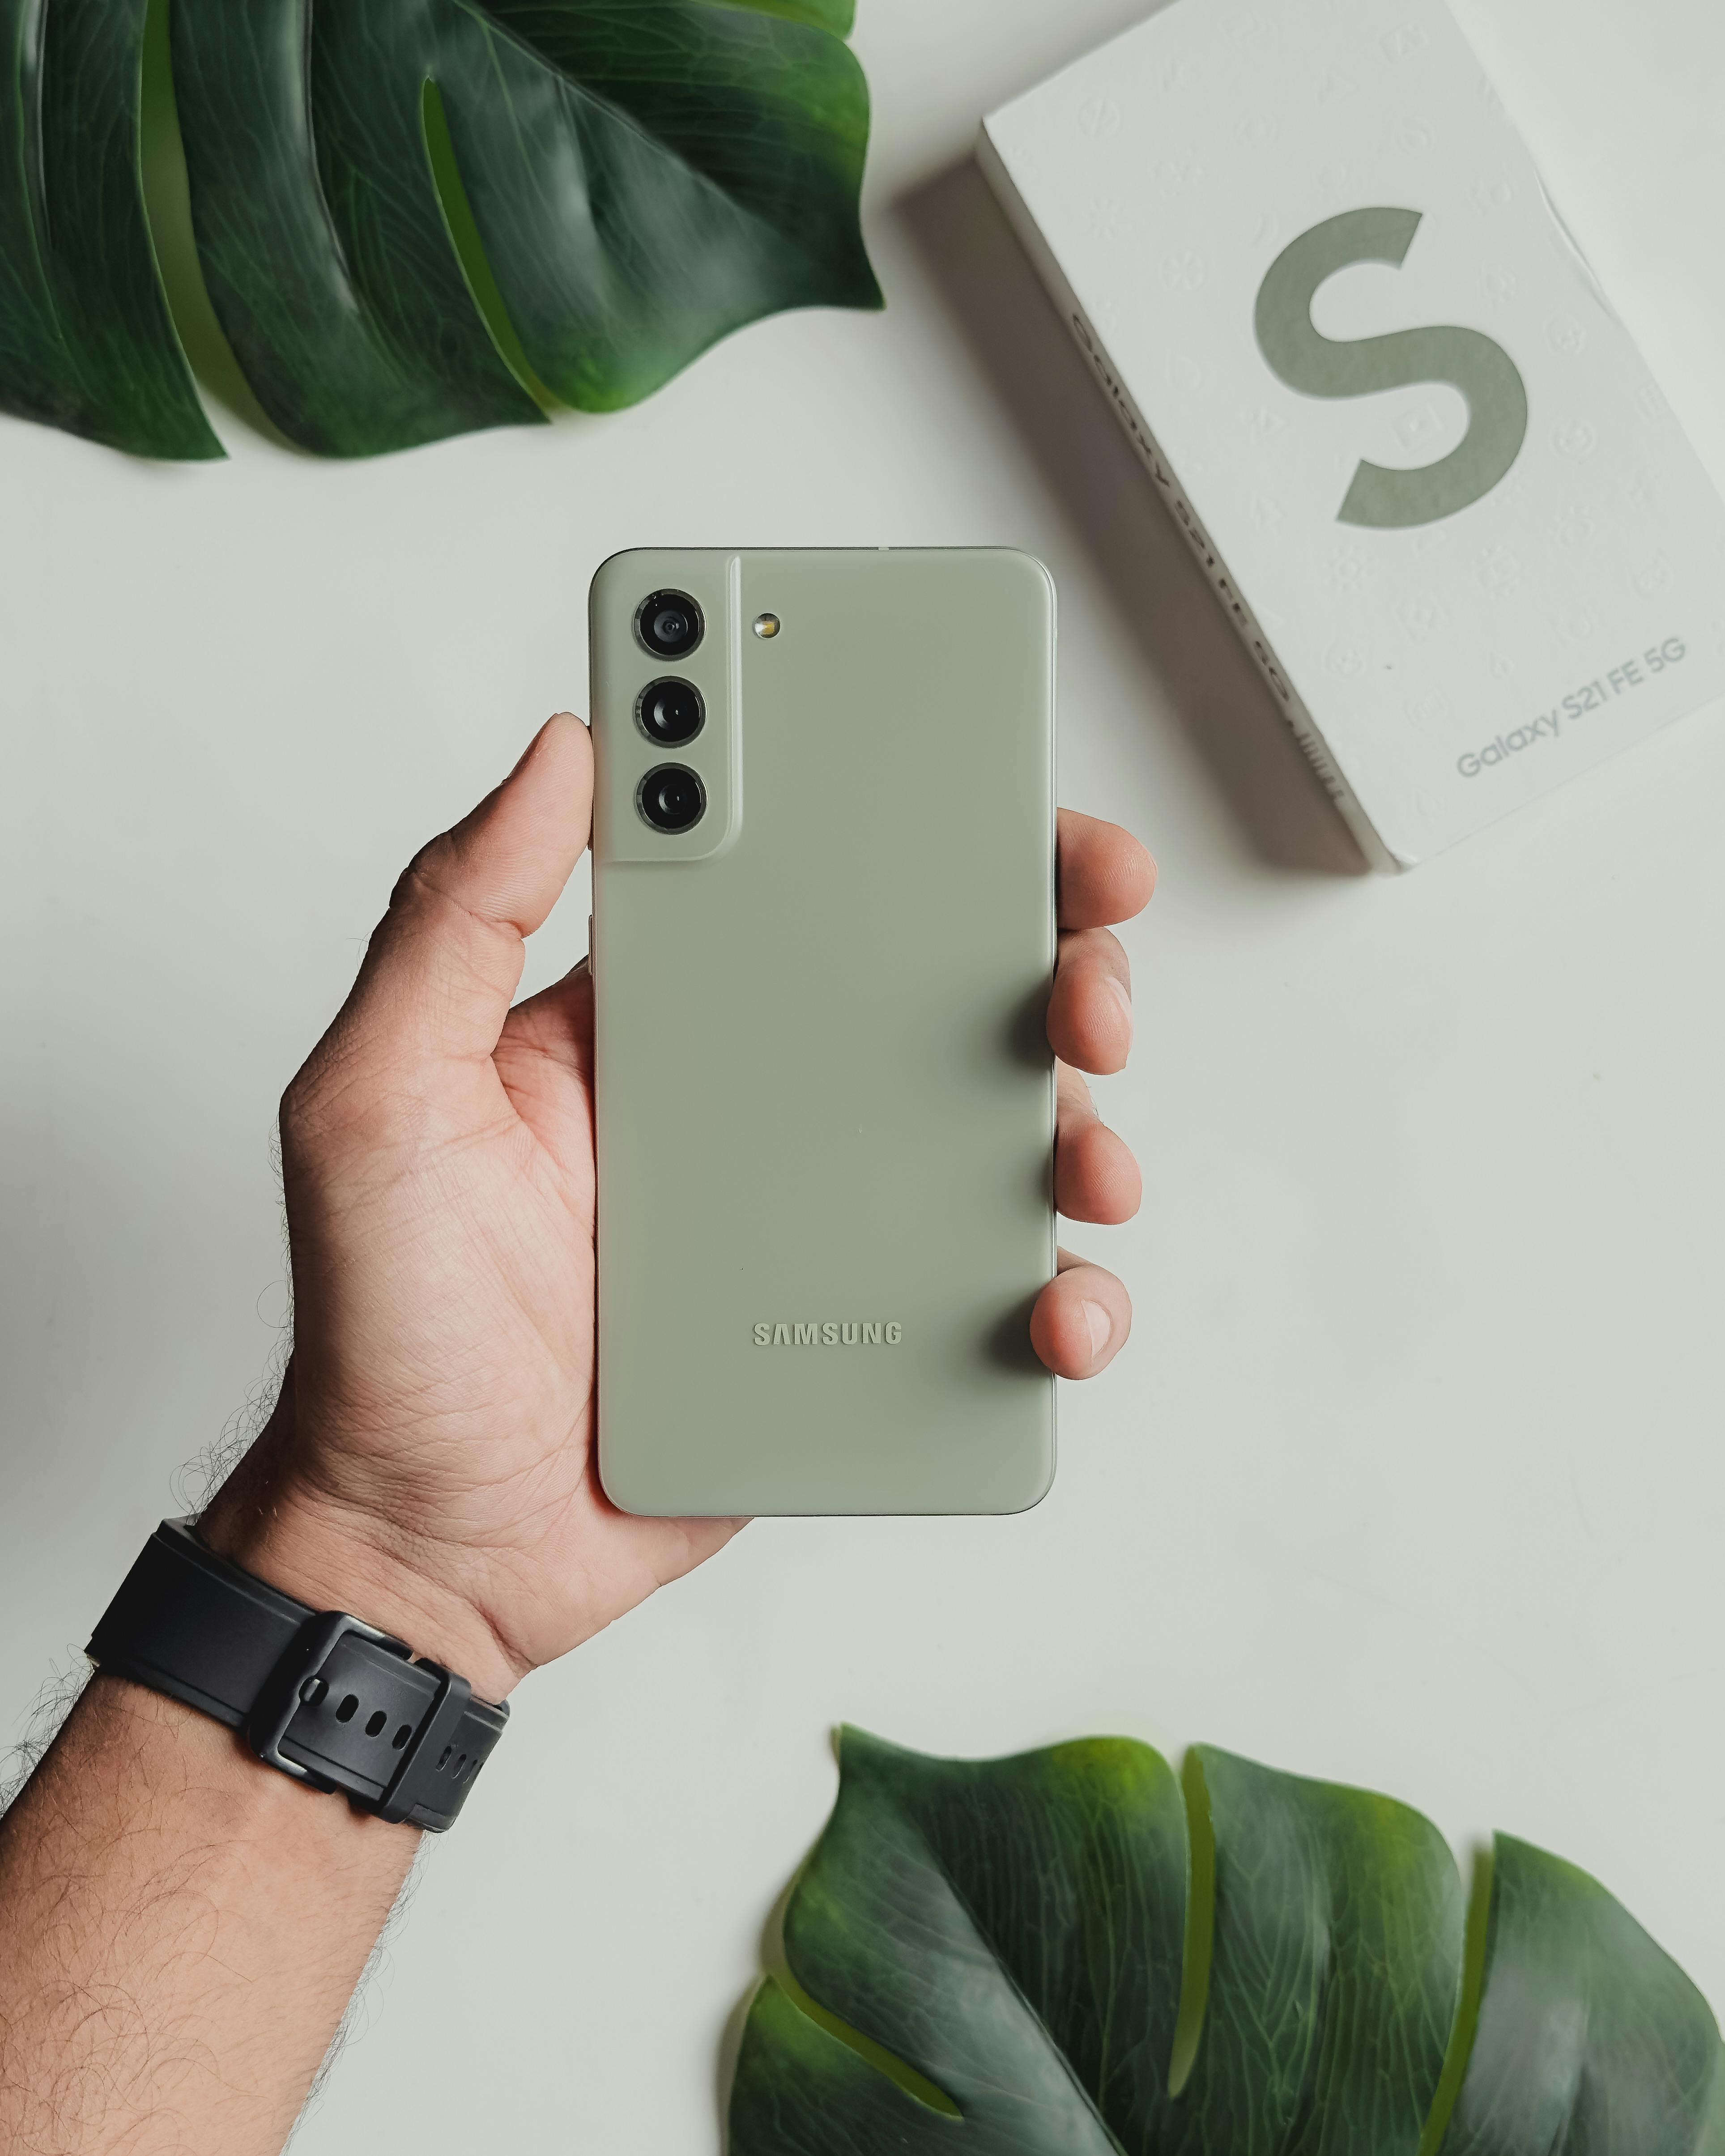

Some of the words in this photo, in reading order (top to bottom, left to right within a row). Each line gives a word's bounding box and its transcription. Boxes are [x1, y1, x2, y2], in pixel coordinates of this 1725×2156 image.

[1253, 207, 1528, 531] S
[1456, 710, 1559, 778] Galaxy
[1561, 680, 1608, 720] S21
[1606, 659, 1644, 694] FE
[1643, 636, 1687, 673] 5G
[753, 1322, 902, 1345] SAMSUNG
